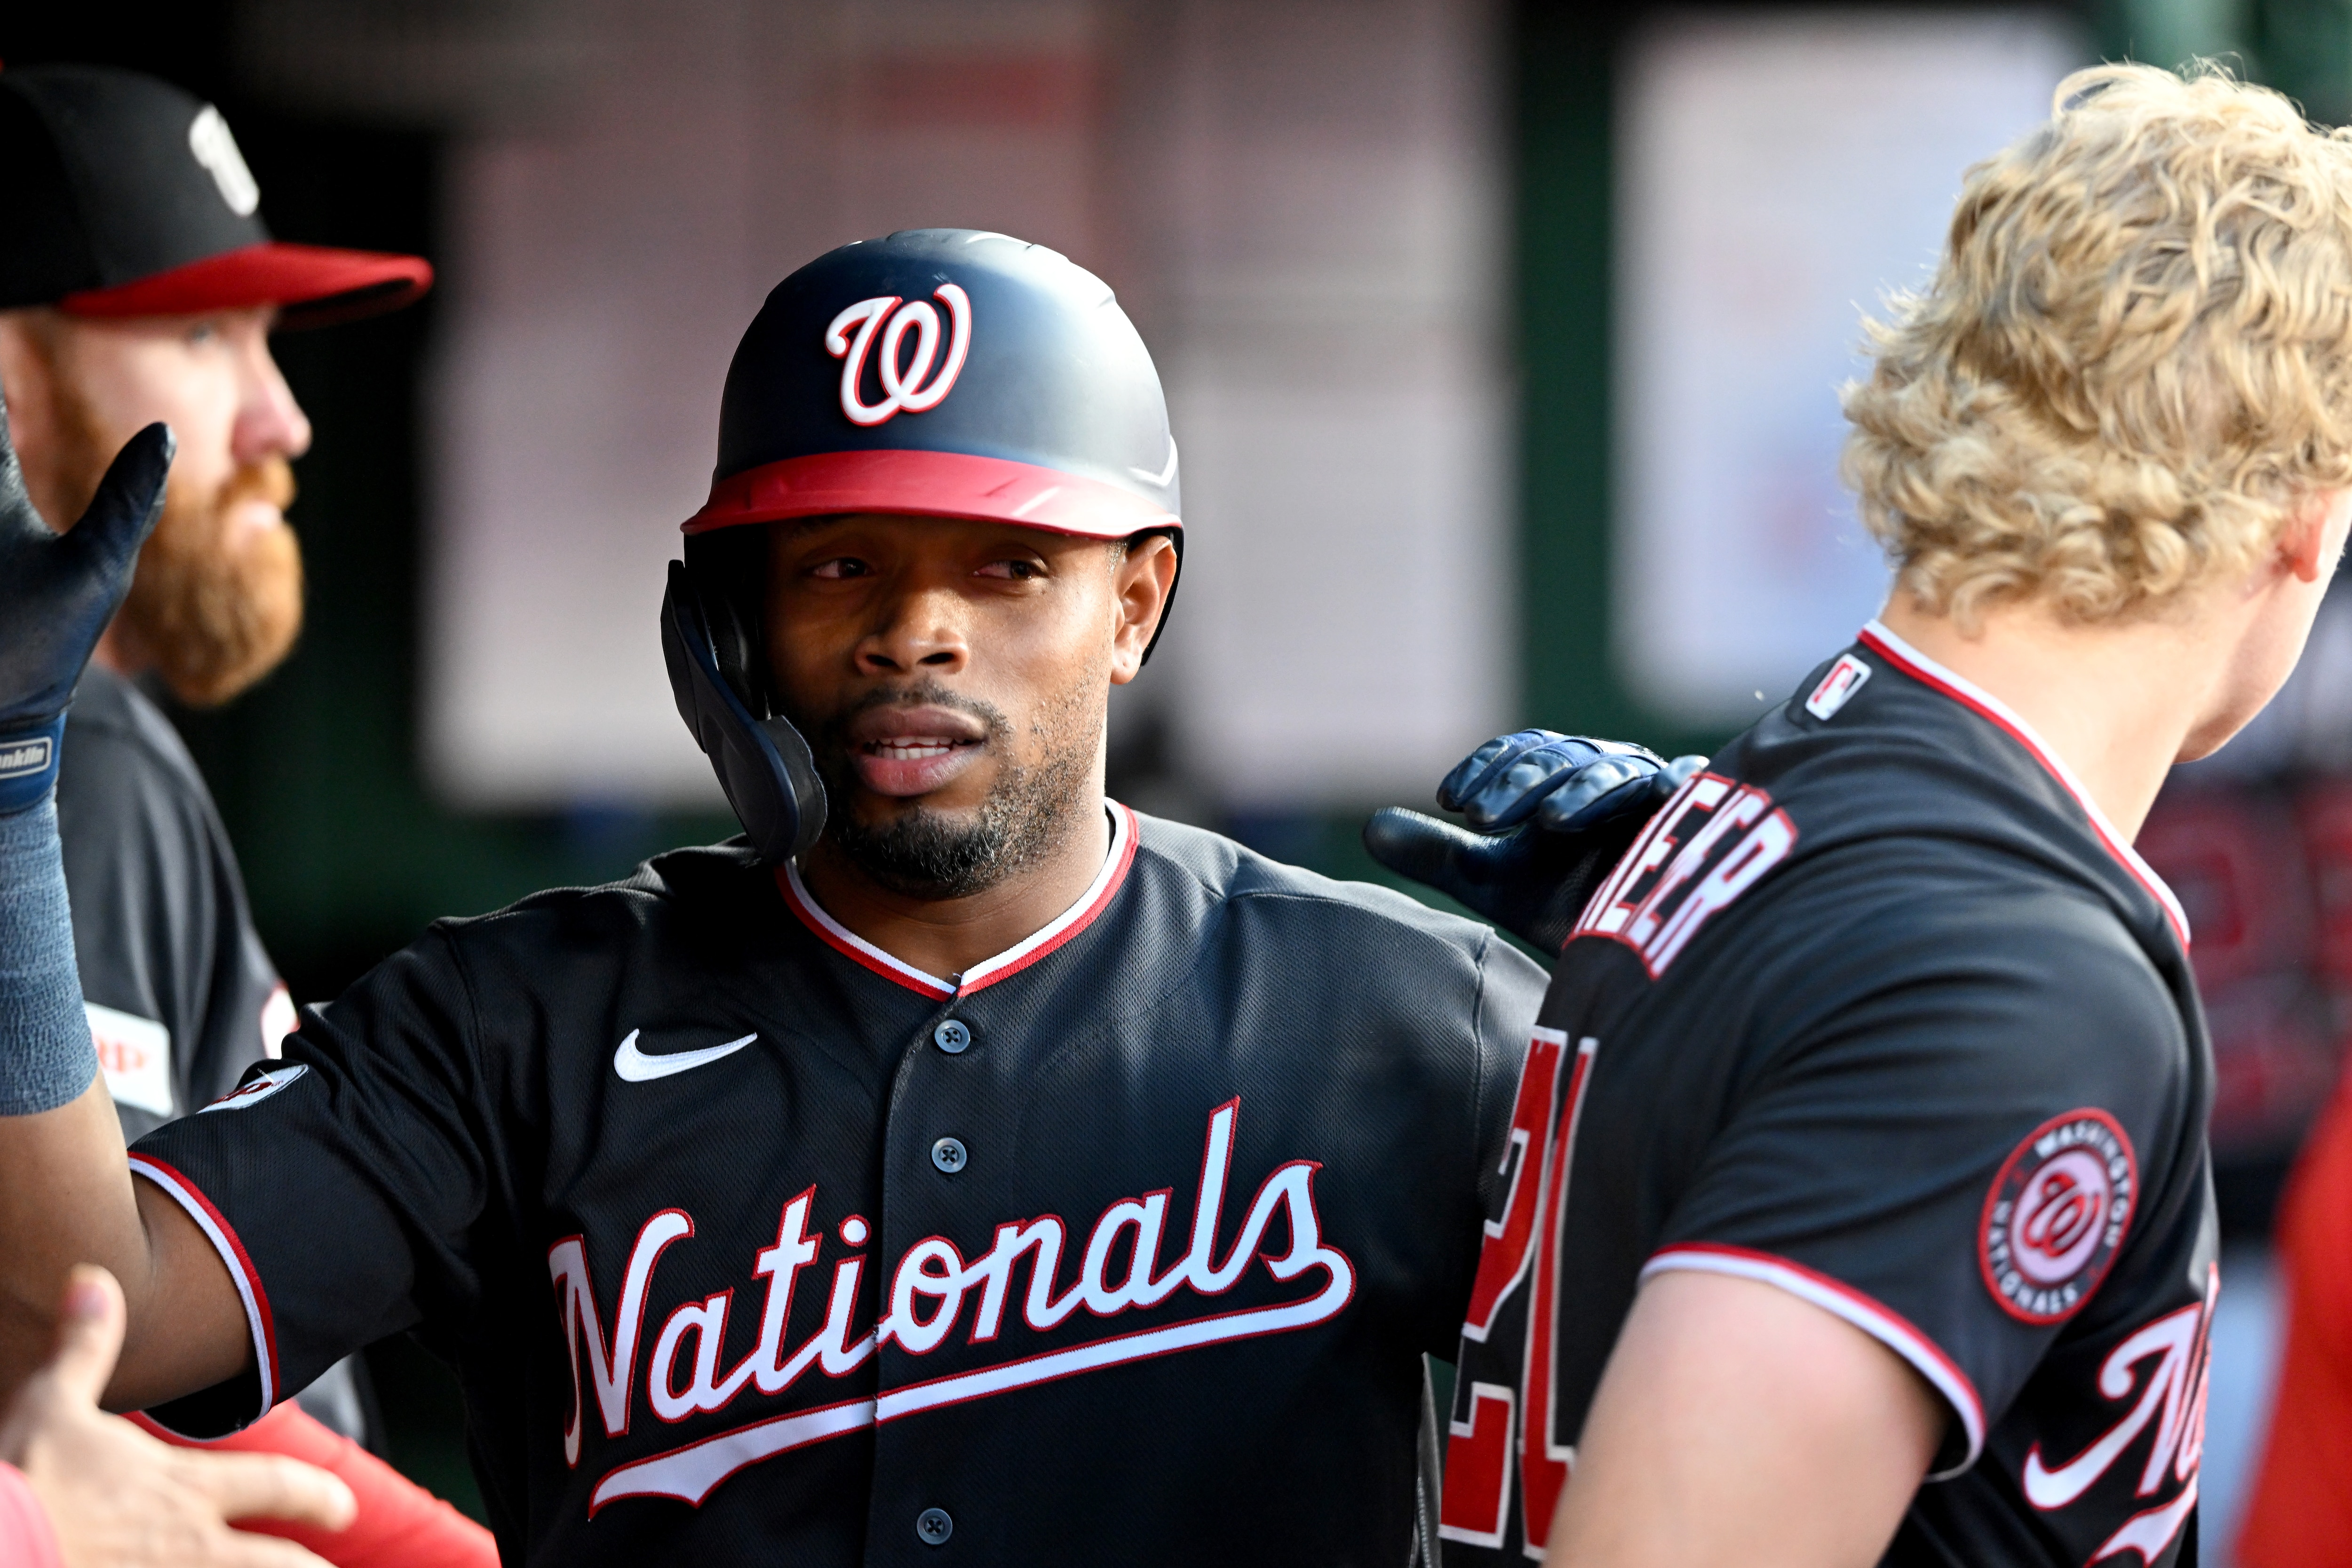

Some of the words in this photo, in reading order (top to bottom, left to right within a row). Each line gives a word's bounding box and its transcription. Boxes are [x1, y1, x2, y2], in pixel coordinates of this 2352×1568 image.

[825, 283, 972, 427] W
[0, 746, 45, 769] nklin
[2034, 1119, 2130, 1248] WASHINGTON
[548, 1095, 1357, 1521] Nationals
